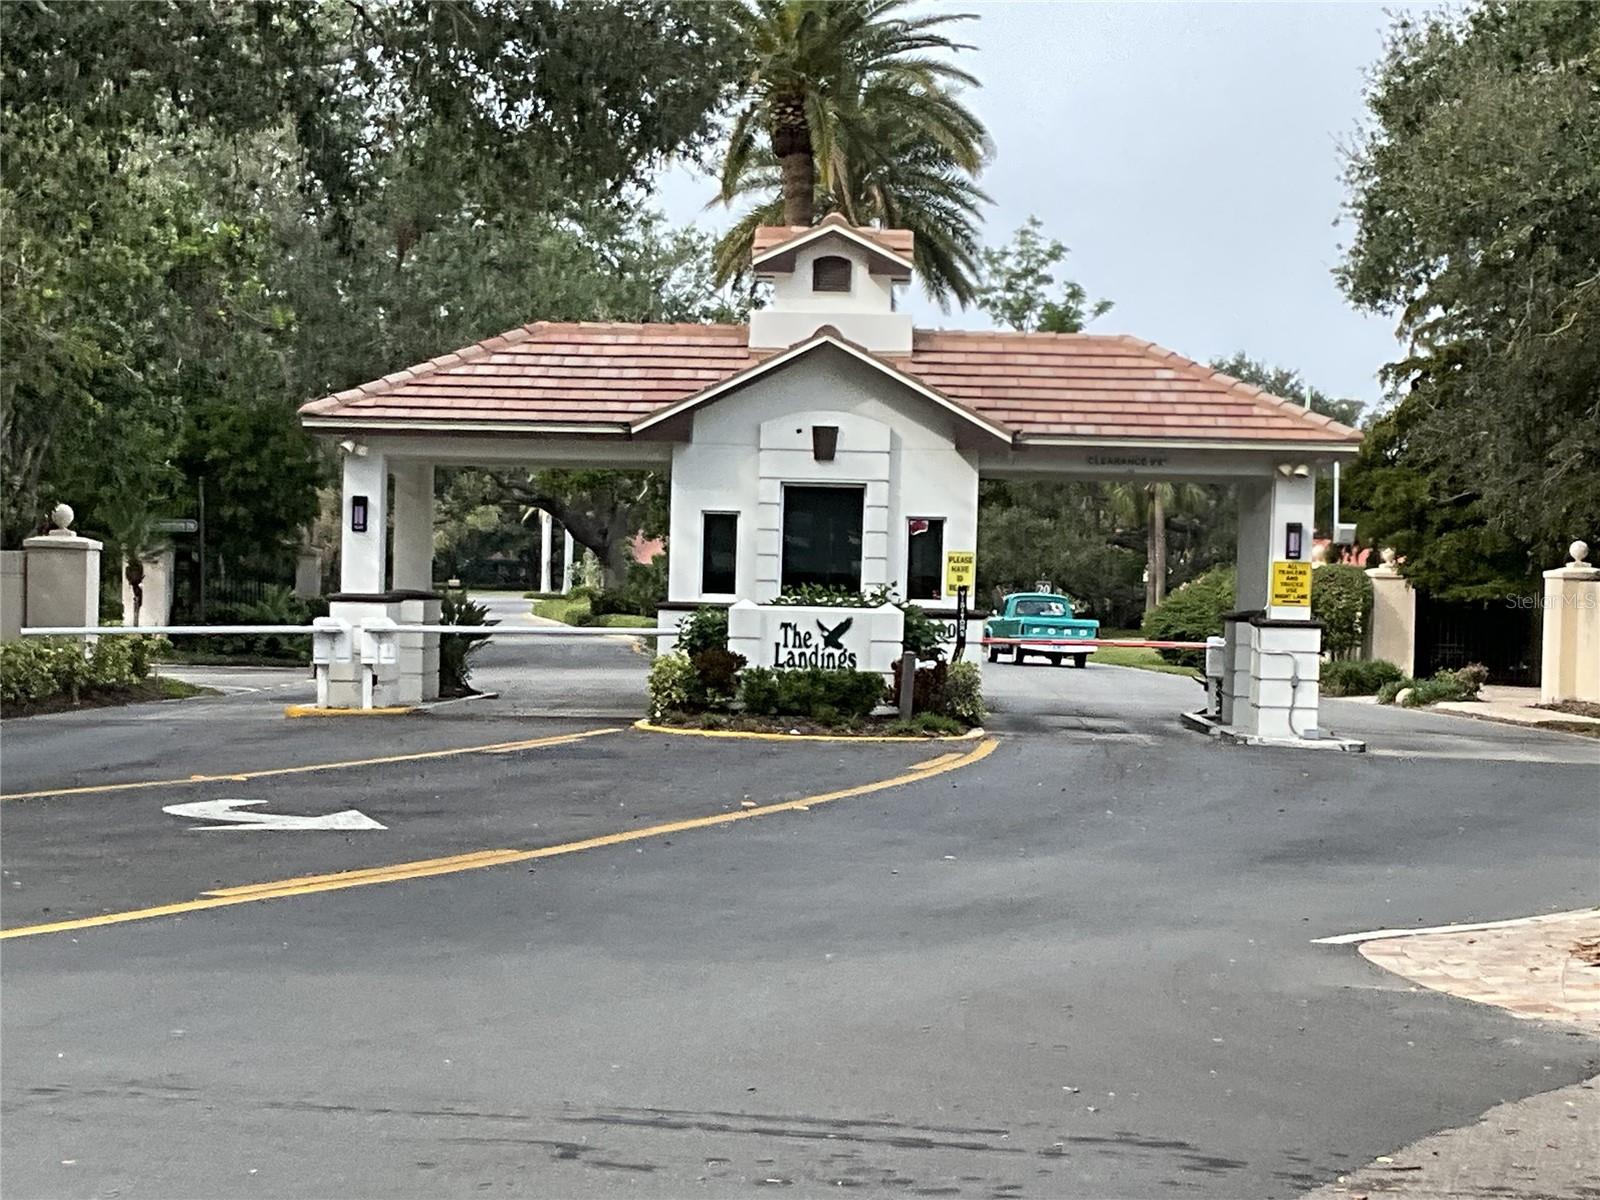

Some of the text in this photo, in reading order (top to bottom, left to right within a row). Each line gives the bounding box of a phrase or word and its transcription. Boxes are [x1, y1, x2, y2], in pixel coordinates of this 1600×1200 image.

[951, 565, 969, 573] HAVE
[780, 622, 812, 648] The
[1032, 628, 1088, 636] FORD
[774, 642, 857, 670] Landings
